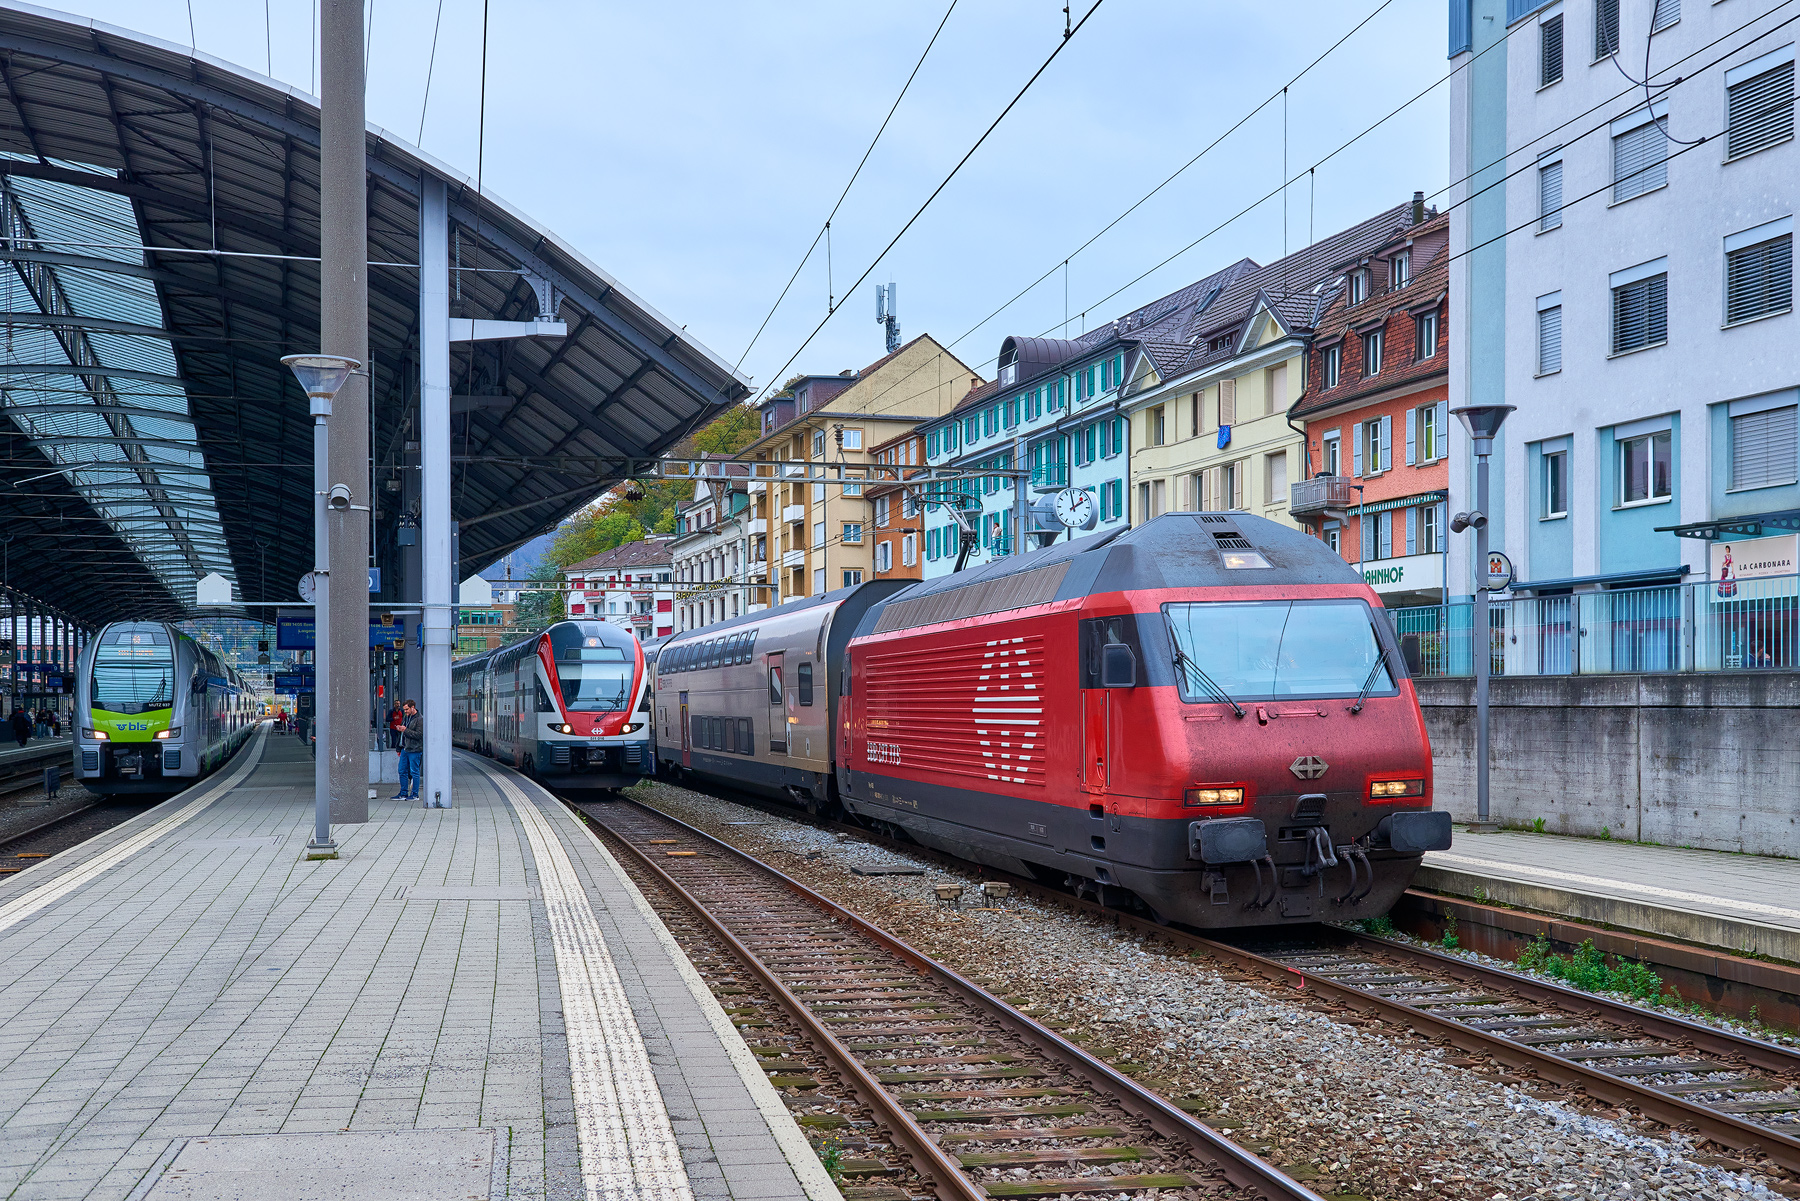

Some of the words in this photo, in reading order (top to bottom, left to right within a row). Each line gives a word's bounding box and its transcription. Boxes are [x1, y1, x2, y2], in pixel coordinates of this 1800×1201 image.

[1750, 560, 1790, 570] CARBONARA
[1362, 566, 1404, 585] AHNHOF
[128, 722, 147, 730] bls
